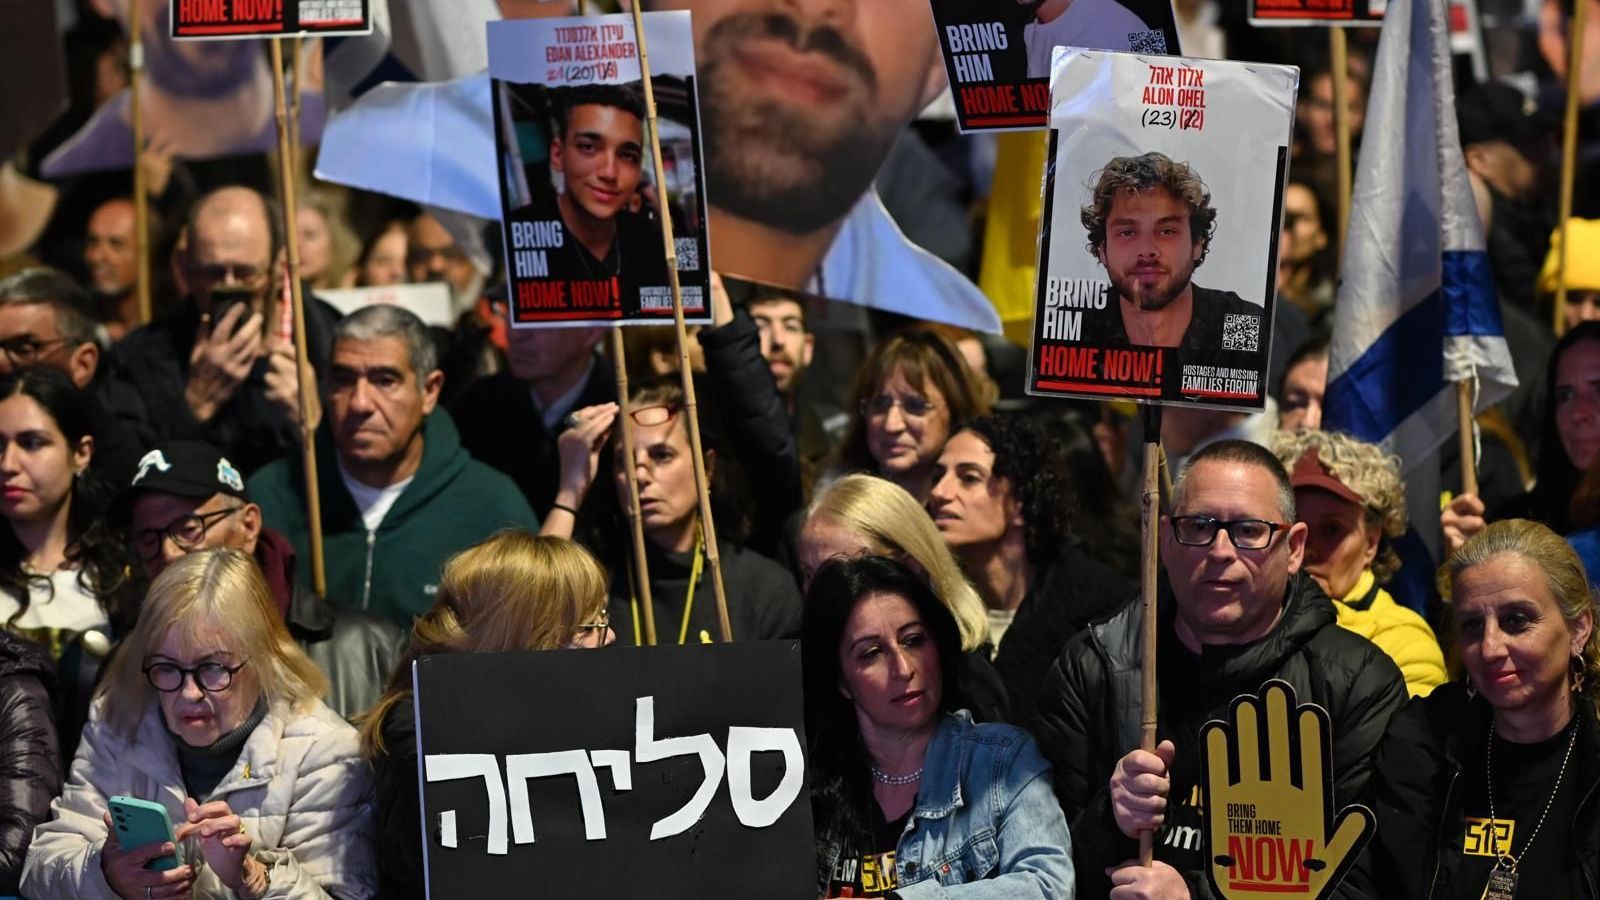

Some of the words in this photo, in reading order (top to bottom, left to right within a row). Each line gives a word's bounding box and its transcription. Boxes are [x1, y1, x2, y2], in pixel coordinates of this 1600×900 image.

[179, 0, 228, 22] HOME
[233, 0, 283, 20] NOW!
[946, 22, 1008, 53] BRING
[545, 46, 572, 62] EDAN
[575, 42, 636, 61] ALEXANDER
[565, 65, 595, 82] (20)
[953, 54, 994, 83] HIM
[1149, 65, 1173, 85] אהל
[1178, 67, 1204, 88] אלון
[961, 86, 1019, 115] HOME
[1020, 84, 1050, 111] NO
[1142, 87, 1174, 106] ALON
[1177, 89, 1206, 109] OHEL
[1142, 108, 1177, 130] (23)
[511, 220, 564, 248] BRING
[514, 250, 549, 278] HIM
[518, 281, 567, 309] HOME
[571, 276, 621, 308] NOW!
[1045, 277, 1108, 310] BRING
[1042, 308, 1083, 342] HIM
[1040, 345, 1099, 379] HOME
[1103, 349, 1163, 385] NOW!
[1182, 364, 1216, 377] HOSTAGES
[1215, 367, 1229, 379] AND
[1229, 368, 1259, 381] MISSING
[1182, 375, 1223, 393] FAMILIES
[1223, 378, 1258, 396] FORUM
[424, 695, 805, 856] סליחה
[1227, 803, 1256, 819] BRING
[1227, 818, 1253, 834] THEM
[1255, 820, 1281, 836] HOME
[1228, 835, 1314, 882] NOW
